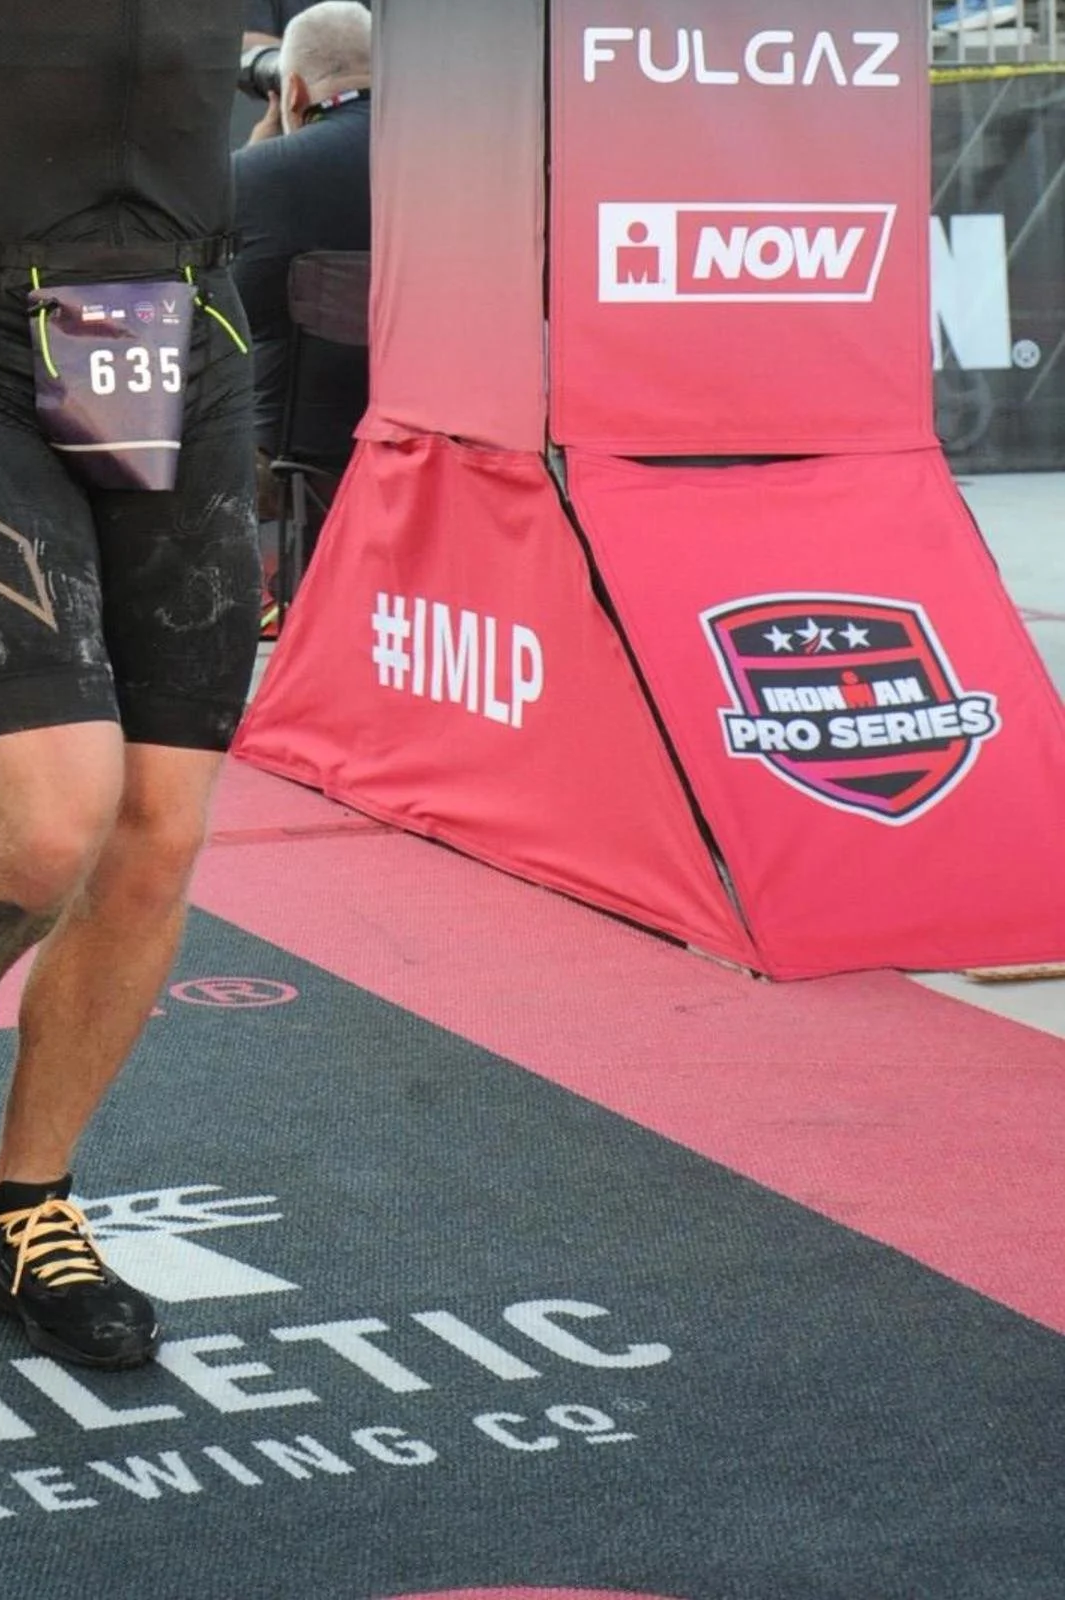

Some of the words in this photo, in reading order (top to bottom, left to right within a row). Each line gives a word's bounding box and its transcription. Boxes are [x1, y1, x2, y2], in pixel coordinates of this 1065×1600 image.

[582, 26, 901, 88] FULGAZ
[692, 226, 865, 281] NOW
[89, 346, 181, 395] 635
[370, 591, 544, 730] #IMLP
[762, 669, 925, 714] IRONMAN
[727, 716, 821, 751] PRO
[828, 700, 991, 749] SERIES
